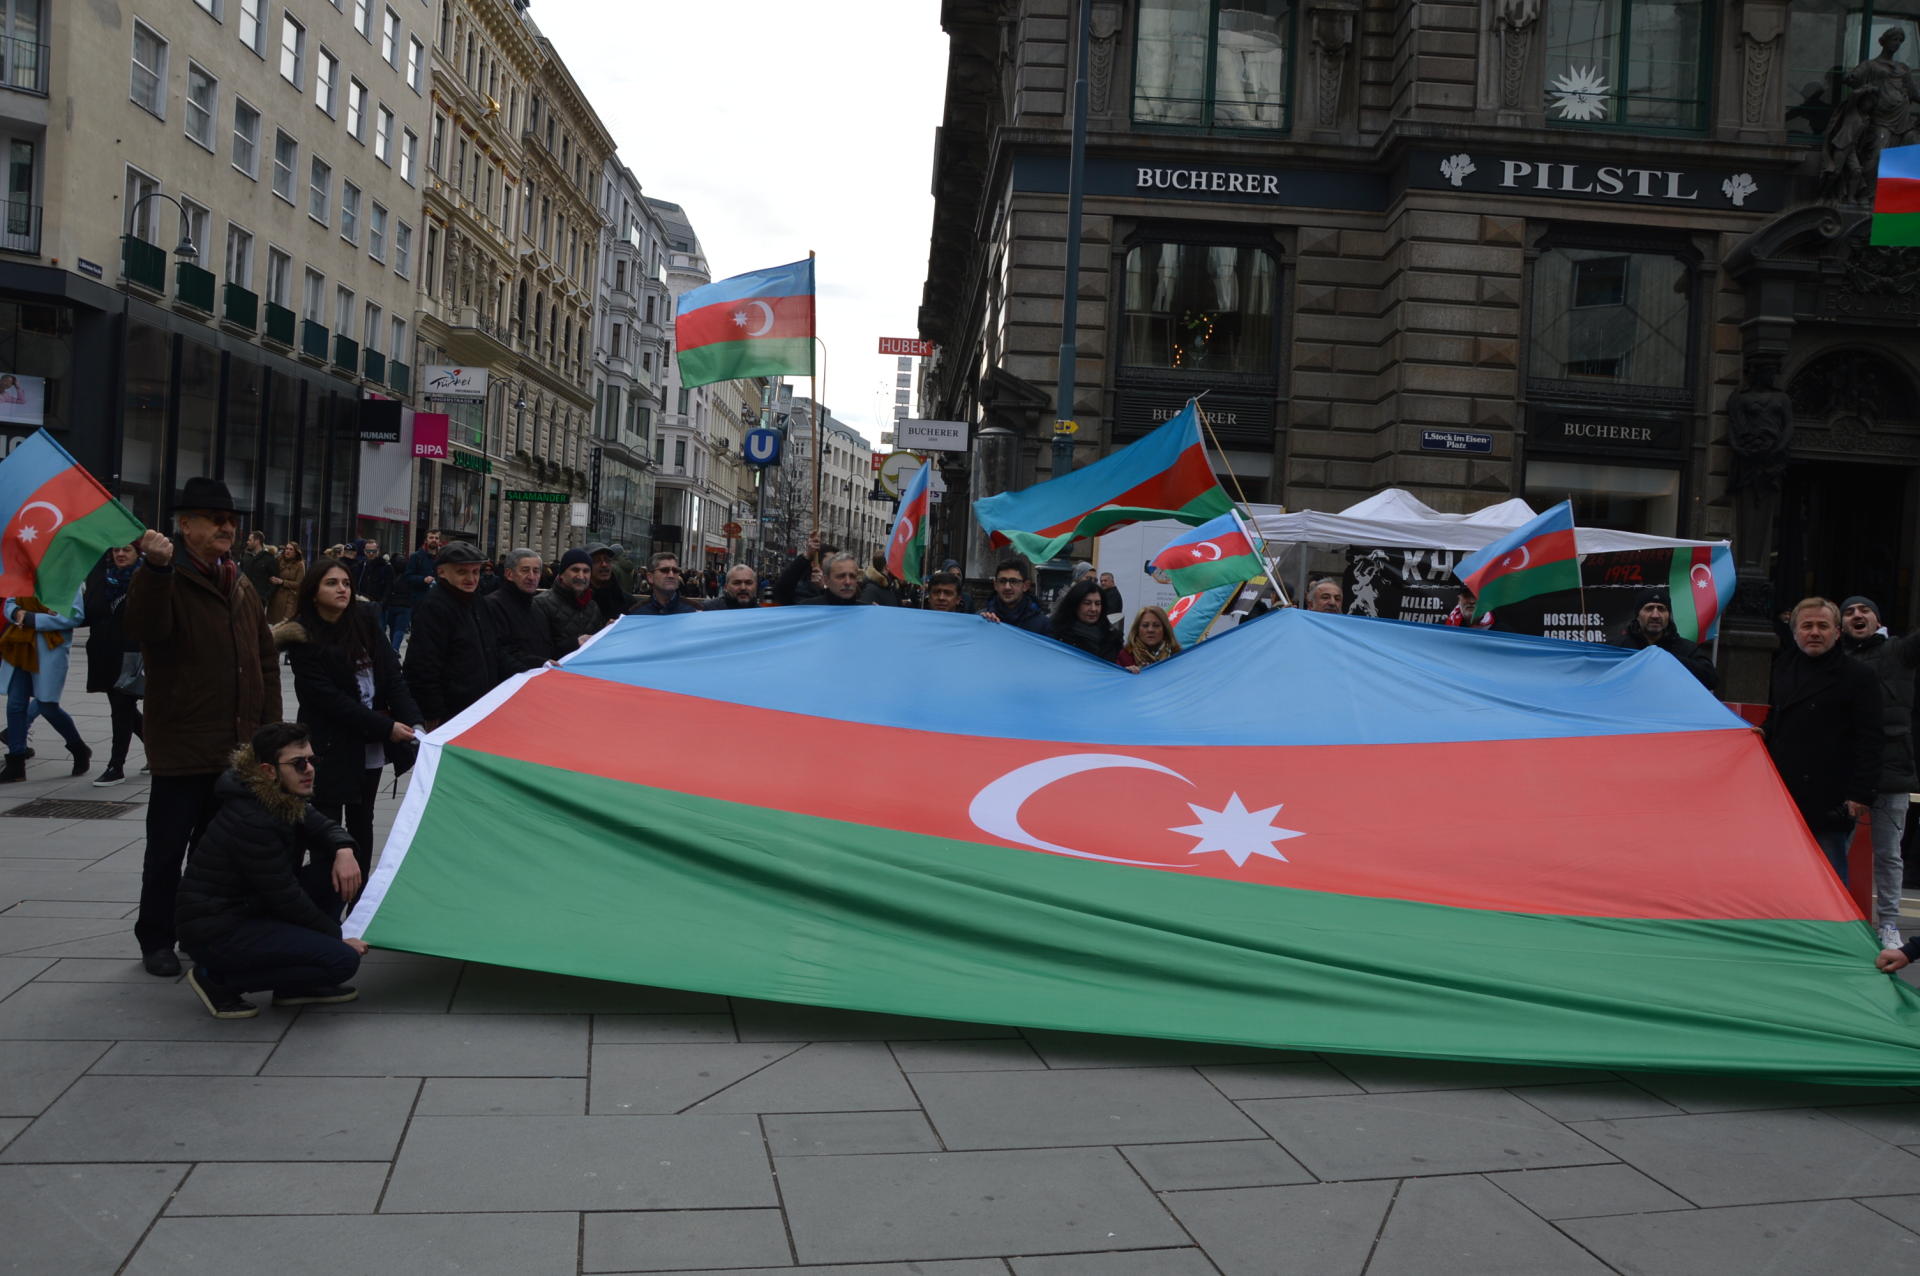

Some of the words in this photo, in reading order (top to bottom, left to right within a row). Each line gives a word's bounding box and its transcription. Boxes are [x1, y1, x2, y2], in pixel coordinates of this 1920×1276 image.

[1136, 167, 1280, 194] BUCHERER
[1497, 159, 1699, 200] PILSTL
[881, 339, 928, 354] HUBER
[1152, 408, 1238, 425] BURER
[360, 431, 398, 441] HUMANIC
[907, 426, 960, 438] BUCHERER
[1453, 434, 1465, 443] im
[1564, 422, 1652, 441] BUCHERER
[415, 443, 444, 456] BIPA
[750, 434, 774, 460] U
[1446, 441, 1468, 449] Platz
[507, 491, 567, 503] SALAMANDER
[1604, 565, 1645, 584] 1992
[1401, 596, 1445, 610] KILLED:
[1543, 613, 1605, 626] HOSTAGES:
